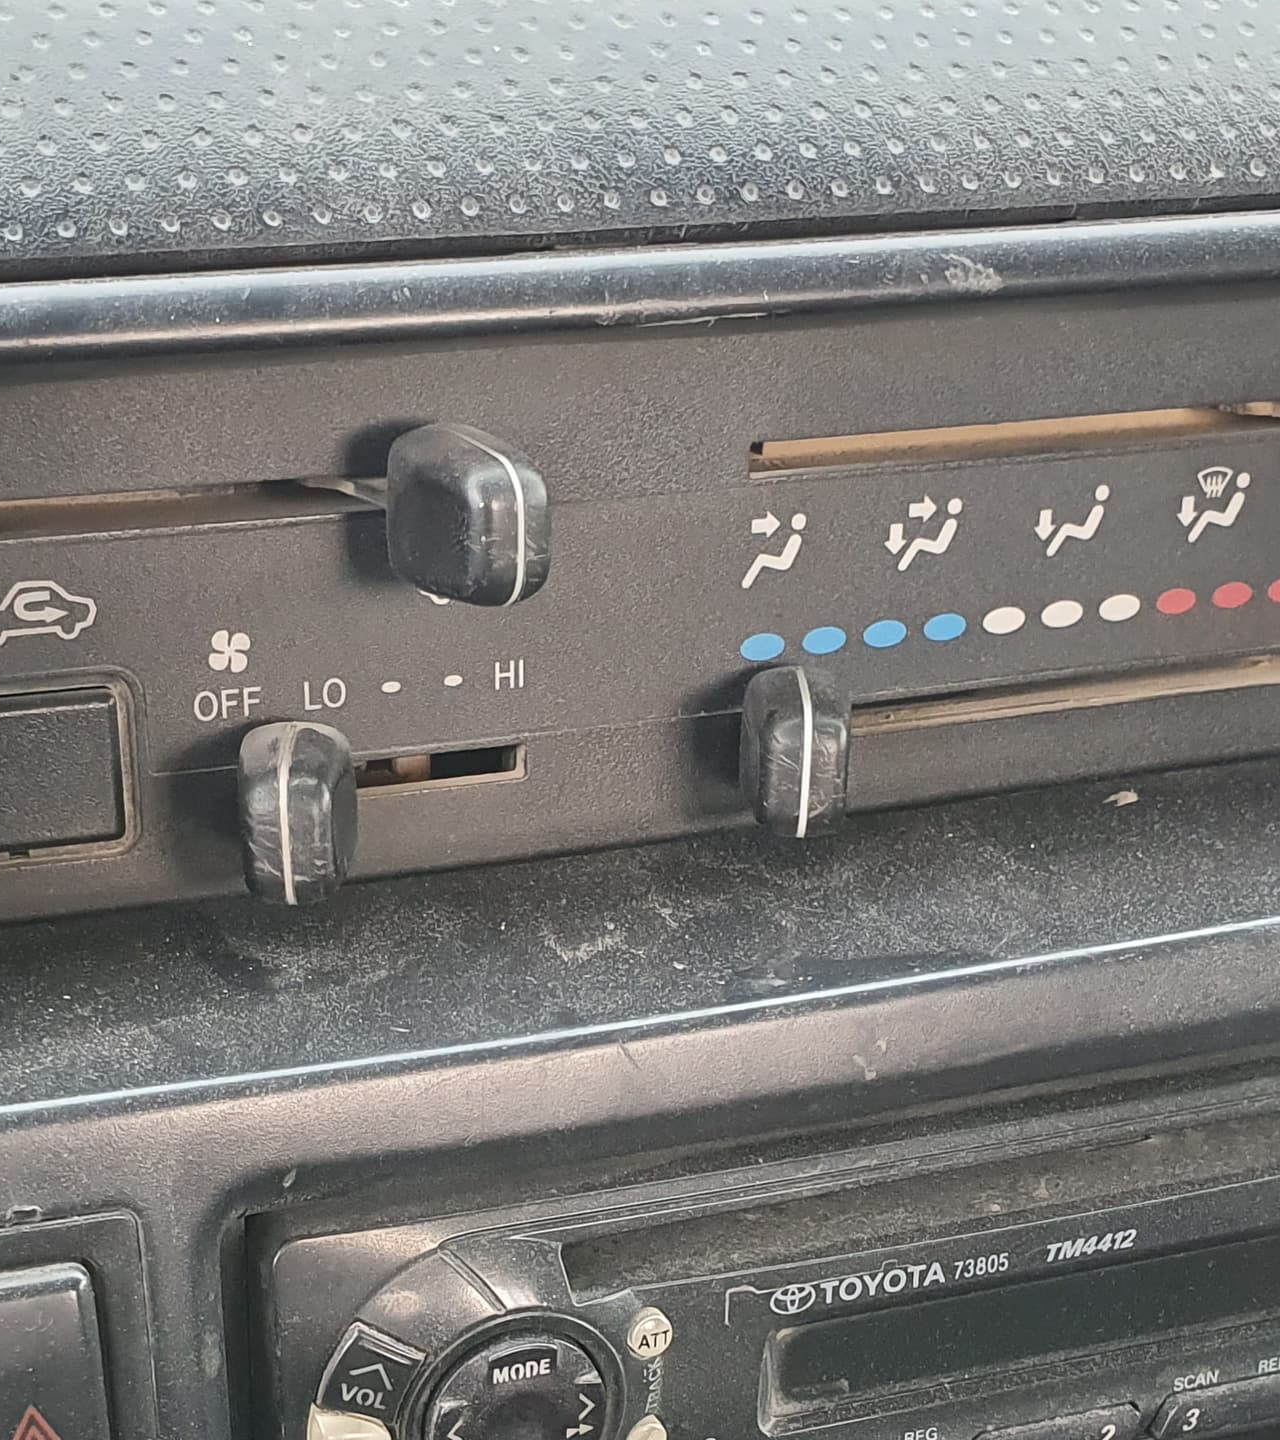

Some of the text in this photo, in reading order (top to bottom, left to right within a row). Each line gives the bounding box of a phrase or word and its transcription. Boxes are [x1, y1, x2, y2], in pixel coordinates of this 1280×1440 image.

[494, 659, 524, 690] HI
[193, 686, 262, 722] OFF
[303, 677, 347, 711] LO
[820, 1229, 1137, 1305] TOYOTA 73805 TM4412
[638, 1329, 670, 1350] ATT
[492, 1358, 552, 1385] MODE
[1173, 1370, 1220, 1392] SCAN
[341, 1382, 387, 1410] VOL
[1182, 1408, 1201, 1432] 3
